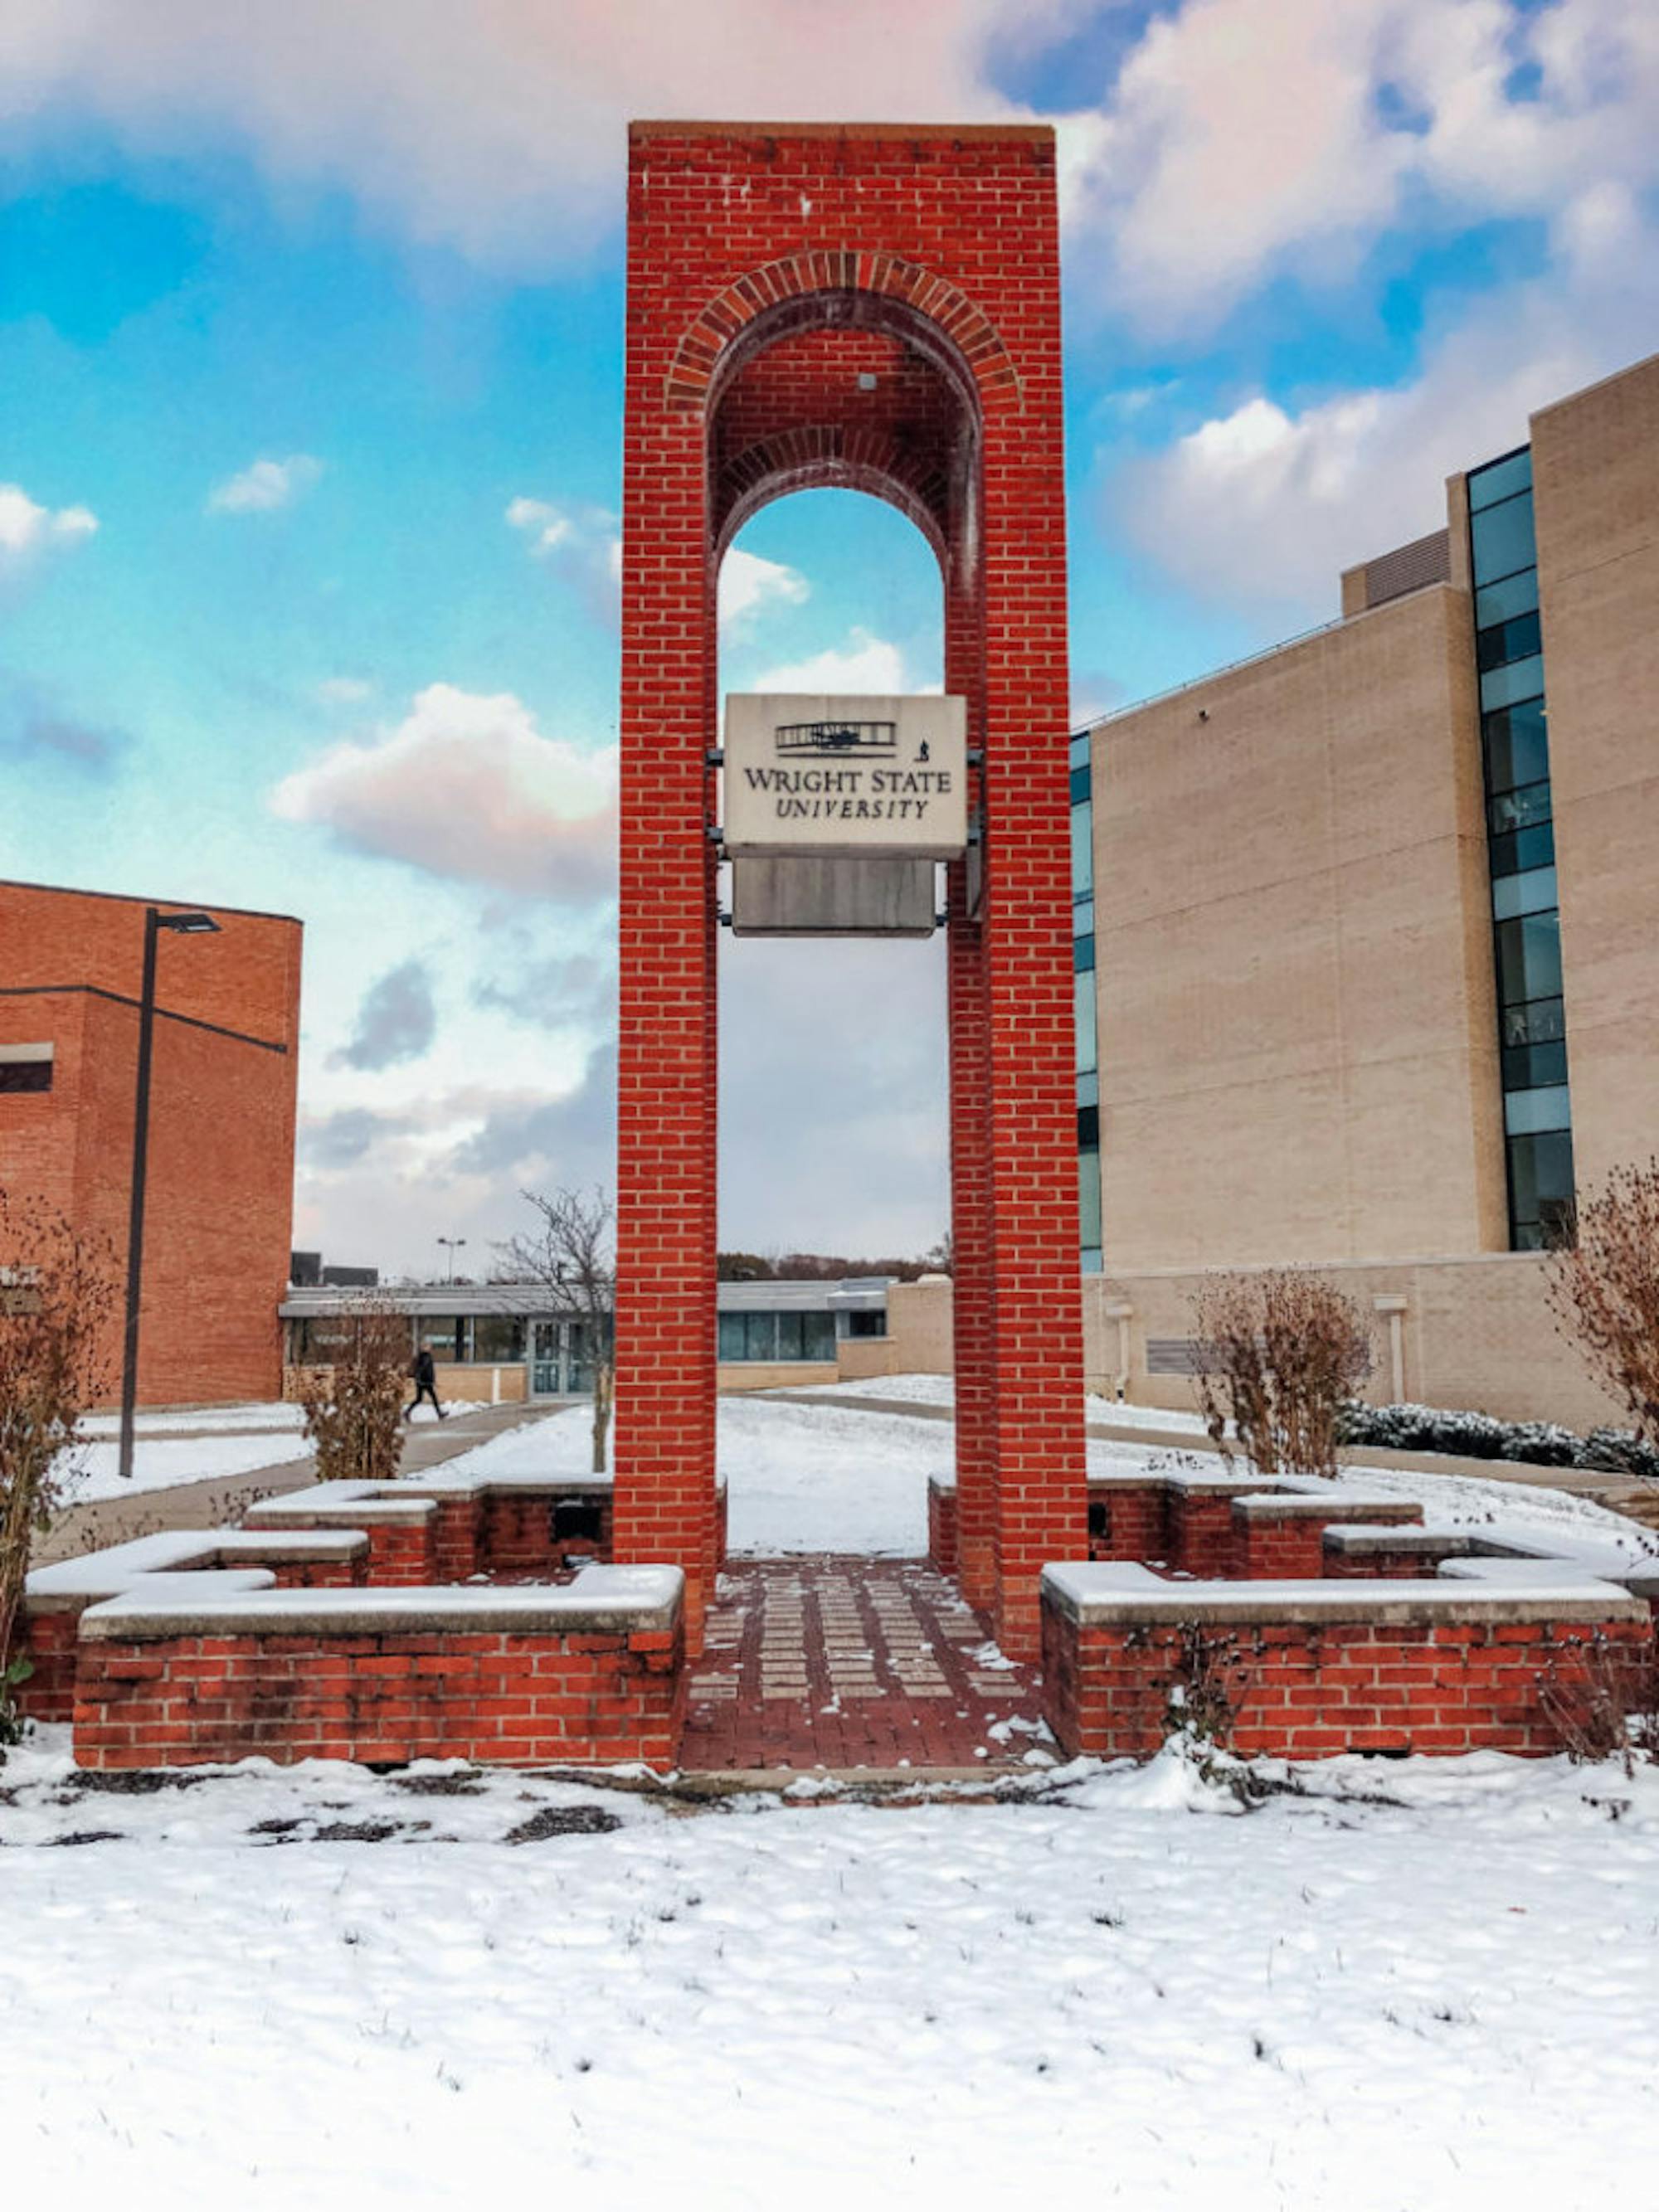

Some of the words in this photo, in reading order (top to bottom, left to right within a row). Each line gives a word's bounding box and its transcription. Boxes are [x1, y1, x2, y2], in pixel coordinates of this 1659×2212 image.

[744, 768, 863, 795] WRIGHT
[871, 770, 952, 793] STATE
[776, 799, 929, 819] UNIVERSITY
